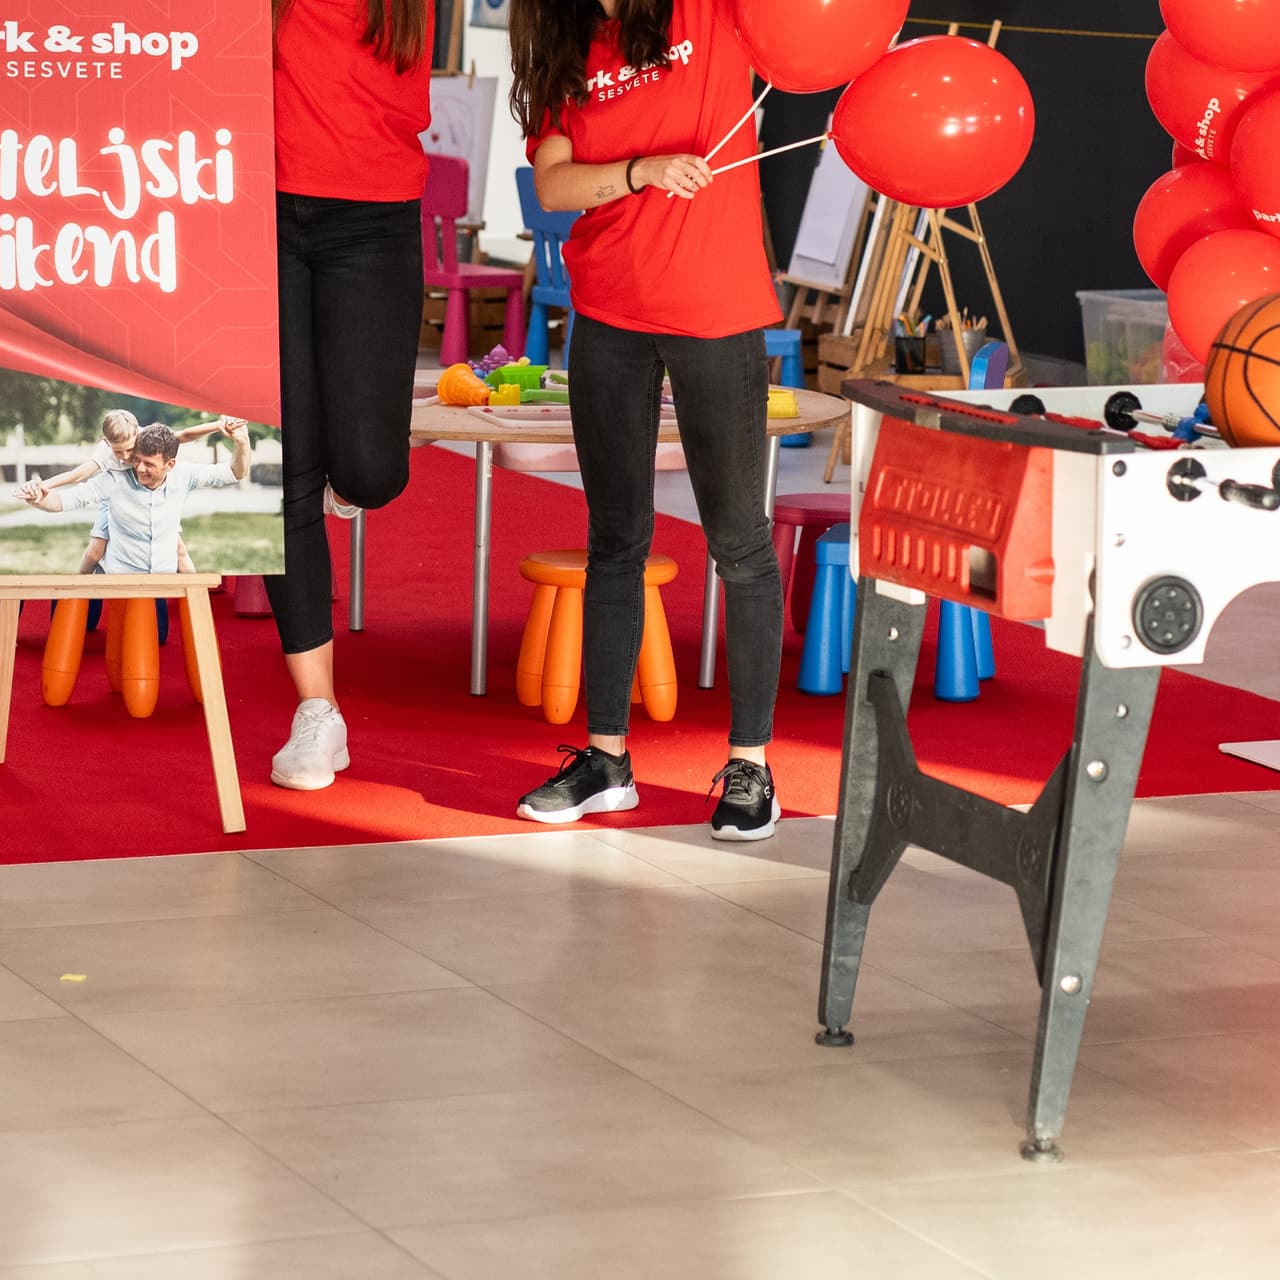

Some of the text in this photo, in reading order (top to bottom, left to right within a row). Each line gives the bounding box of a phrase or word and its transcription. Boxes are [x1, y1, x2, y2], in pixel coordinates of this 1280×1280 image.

[43, 24, 83, 54] &
[91, 22, 199, 71] shop
[6, 60, 124, 79] SESVETE
[586, 69, 616, 93] rk
[598, 70, 660, 102] SESVETE
[1196, 97, 1221, 137] shop
